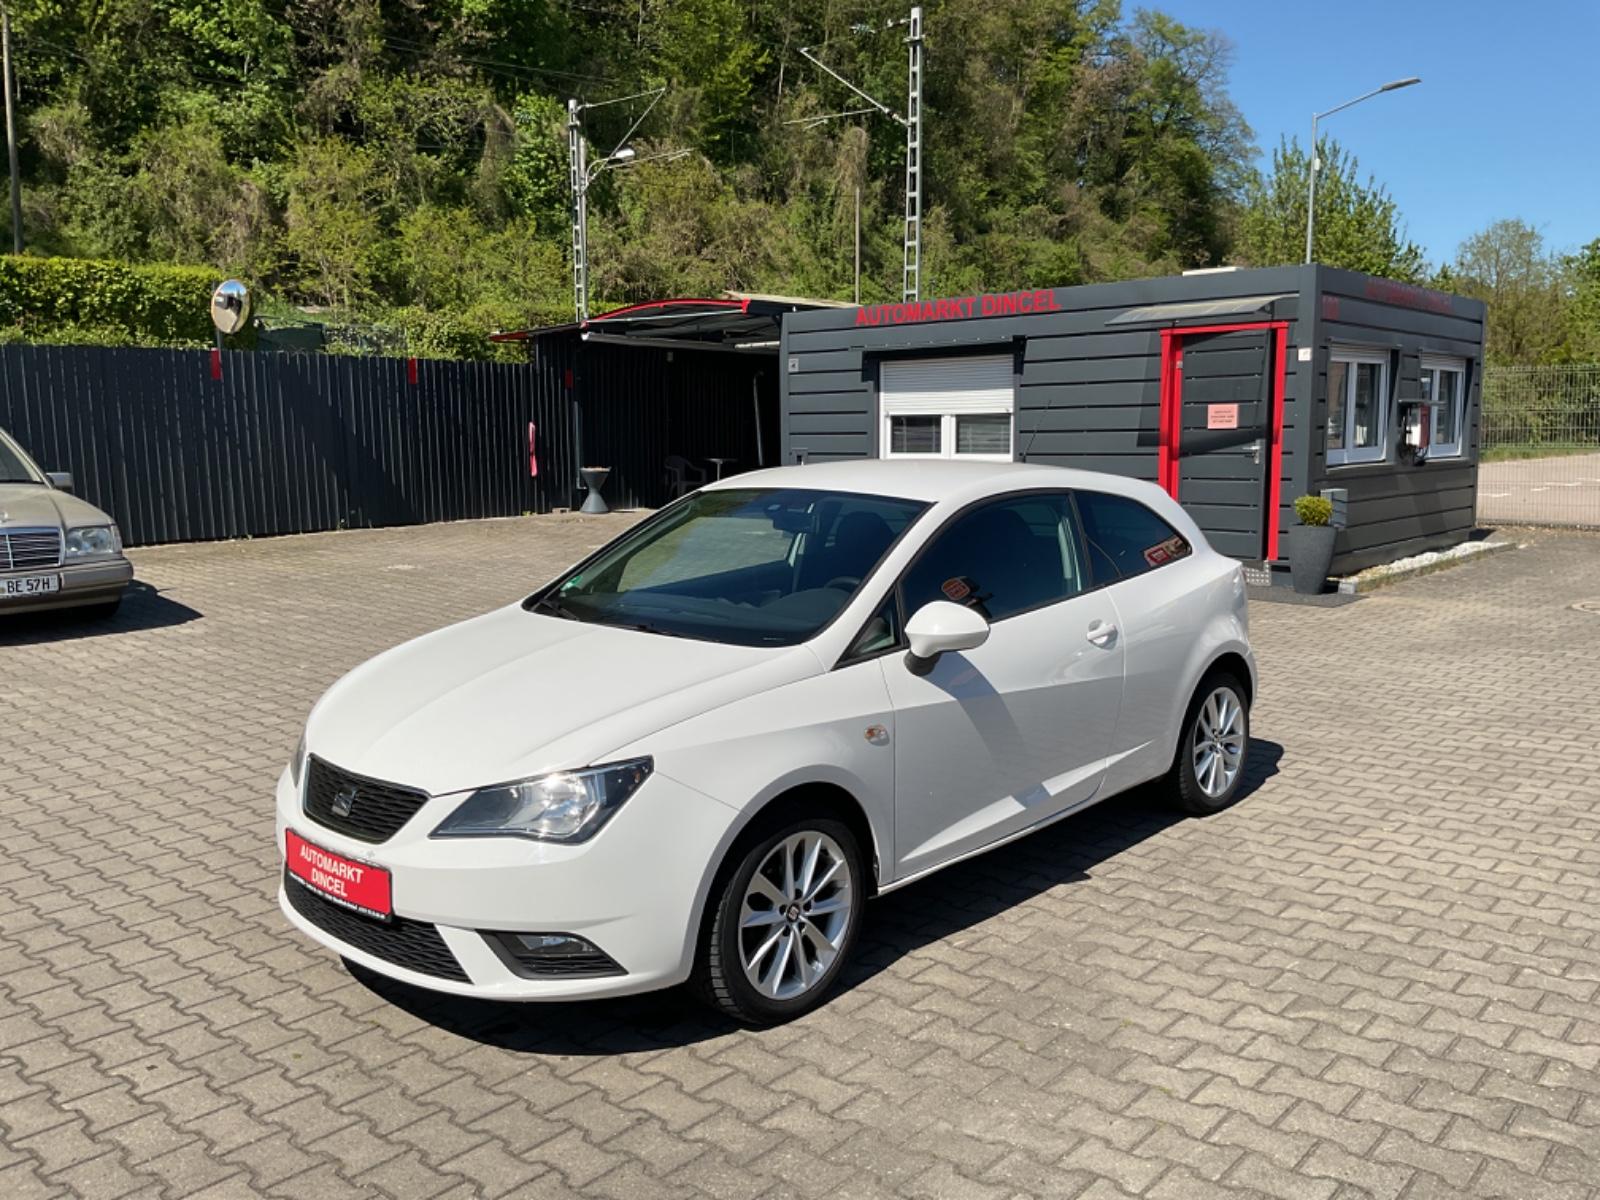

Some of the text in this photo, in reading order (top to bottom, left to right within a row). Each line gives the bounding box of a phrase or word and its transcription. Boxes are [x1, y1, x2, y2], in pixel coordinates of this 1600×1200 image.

[855, 288, 1061, 326] AUTOMARKT DINCEL
[7, 577, 50, 594] BE 57H
[300, 844, 365, 884] AUTOMARKT
[311, 867, 348, 898] DINCEL
